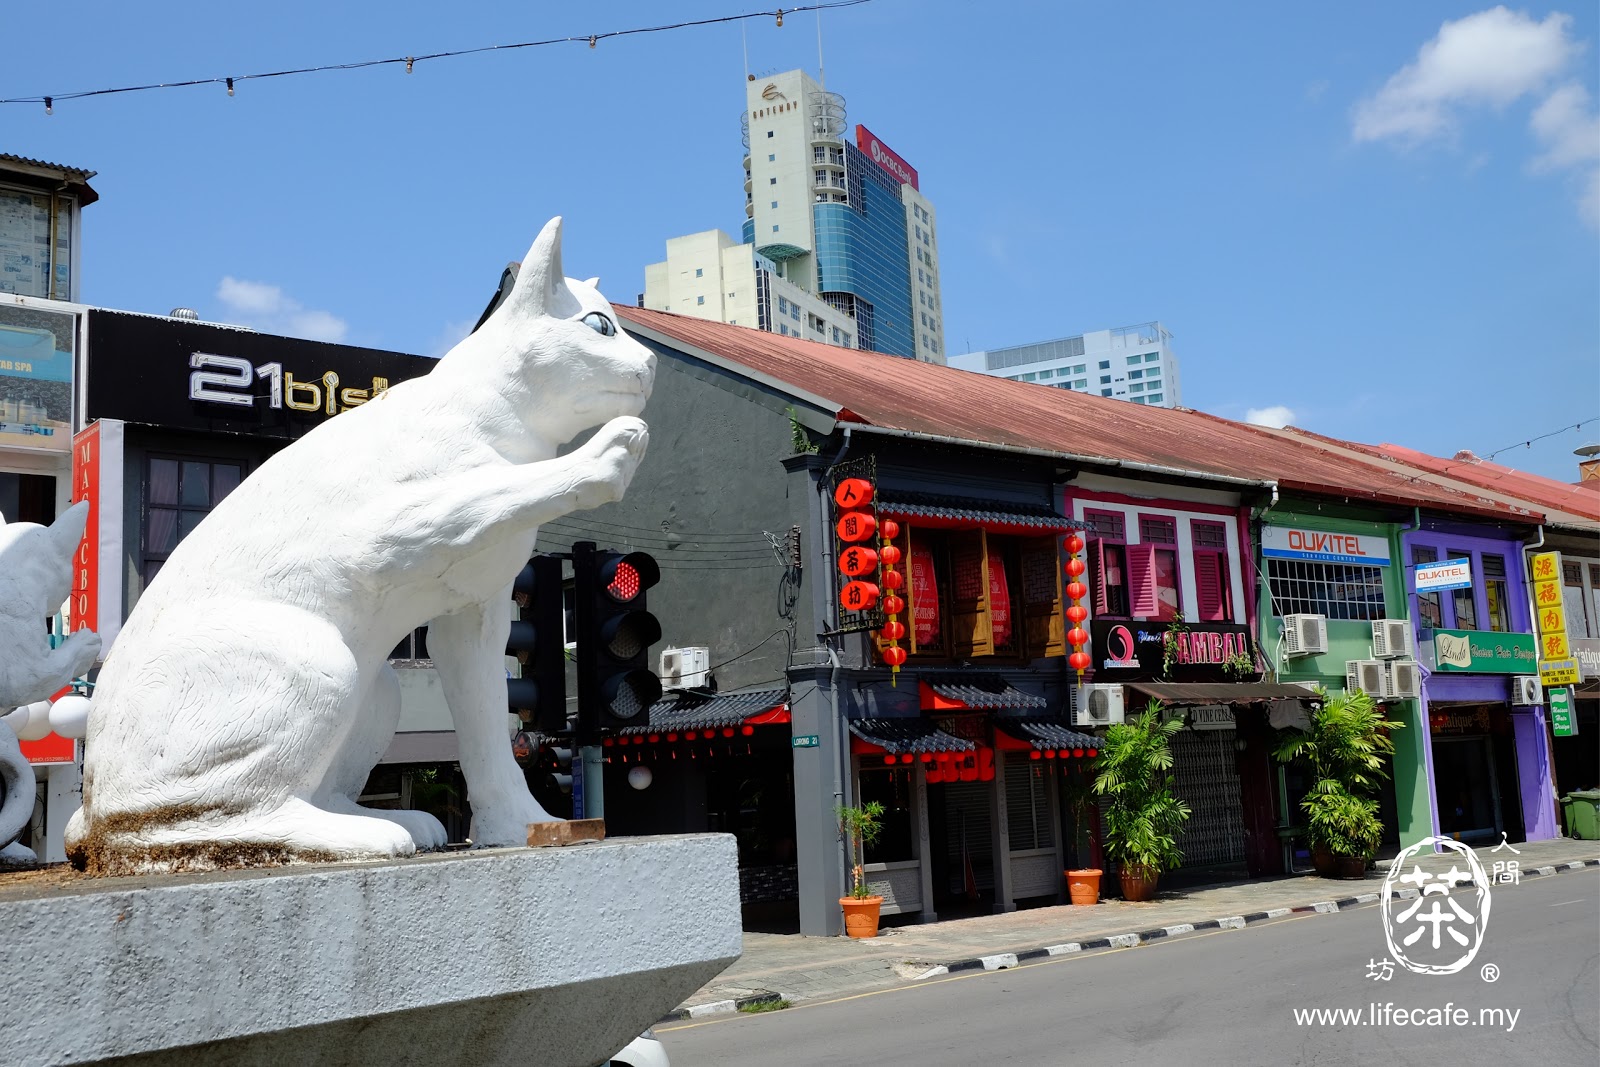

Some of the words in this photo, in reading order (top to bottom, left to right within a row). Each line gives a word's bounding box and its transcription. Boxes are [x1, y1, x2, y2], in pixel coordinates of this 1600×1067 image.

[753, 101, 798, 119] GATEWAY
[880, 152, 898, 174] OCBC
[898, 164, 913, 185] Bank
[15, 362, 32, 372] SPA
[1288, 531, 1366, 555] OUKITEL
[1302, 552, 1330, 561] SERVICE
[1418, 568, 1465, 581] OUKITEL
[1495, 645, 1511, 659] Hair
[1513, 645, 1534, 662] Design
[1554, 722, 1570, 731] Design
[794, 738, 809, 746] LORONG
